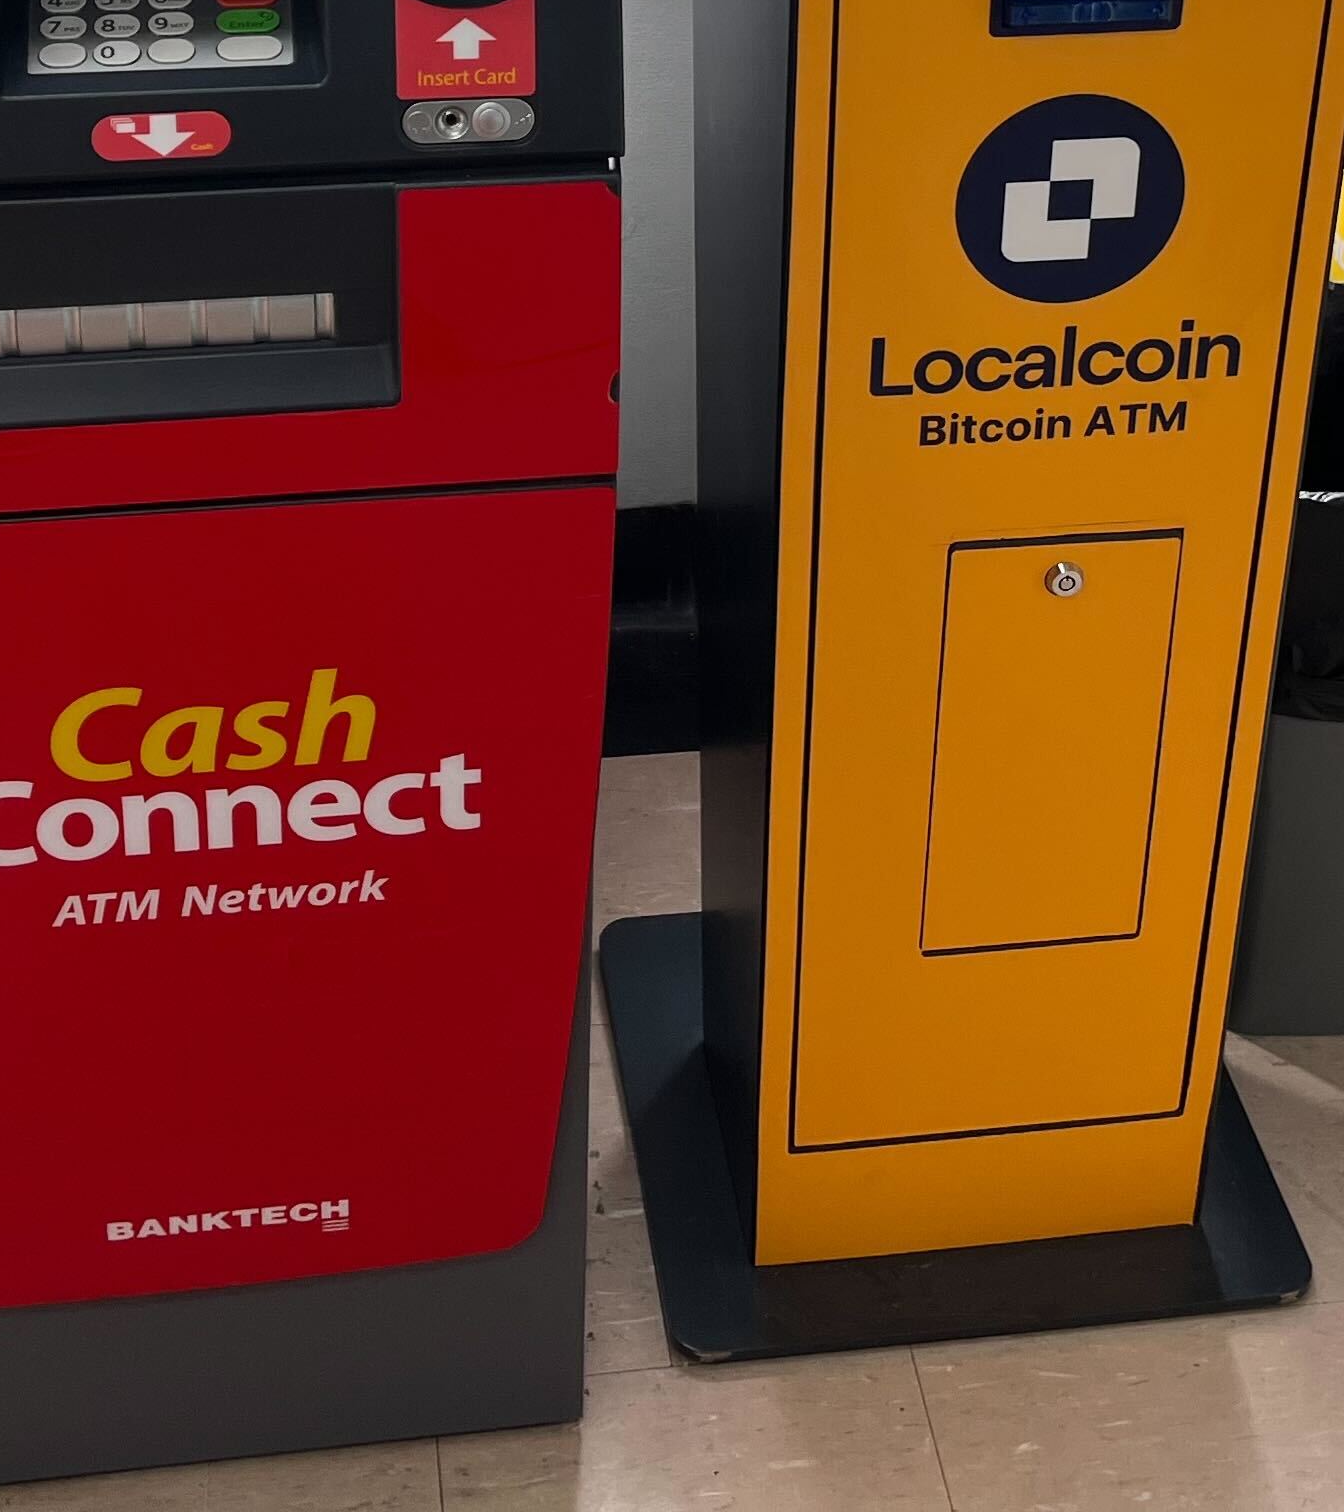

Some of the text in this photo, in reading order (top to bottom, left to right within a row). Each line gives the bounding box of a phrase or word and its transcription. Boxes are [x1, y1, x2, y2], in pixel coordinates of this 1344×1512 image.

[417, 65, 517, 88] Insert Card
[190, 142, 214, 151] Cash
[868, 320, 1241, 398] Localcoin
[918, 400, 1189, 448] Bitcoin ATM
[50, 667, 378, 782] Cash
[52, 869, 389, 928] ATM Network
[106, 1199, 350, 1241] BANKTECH
